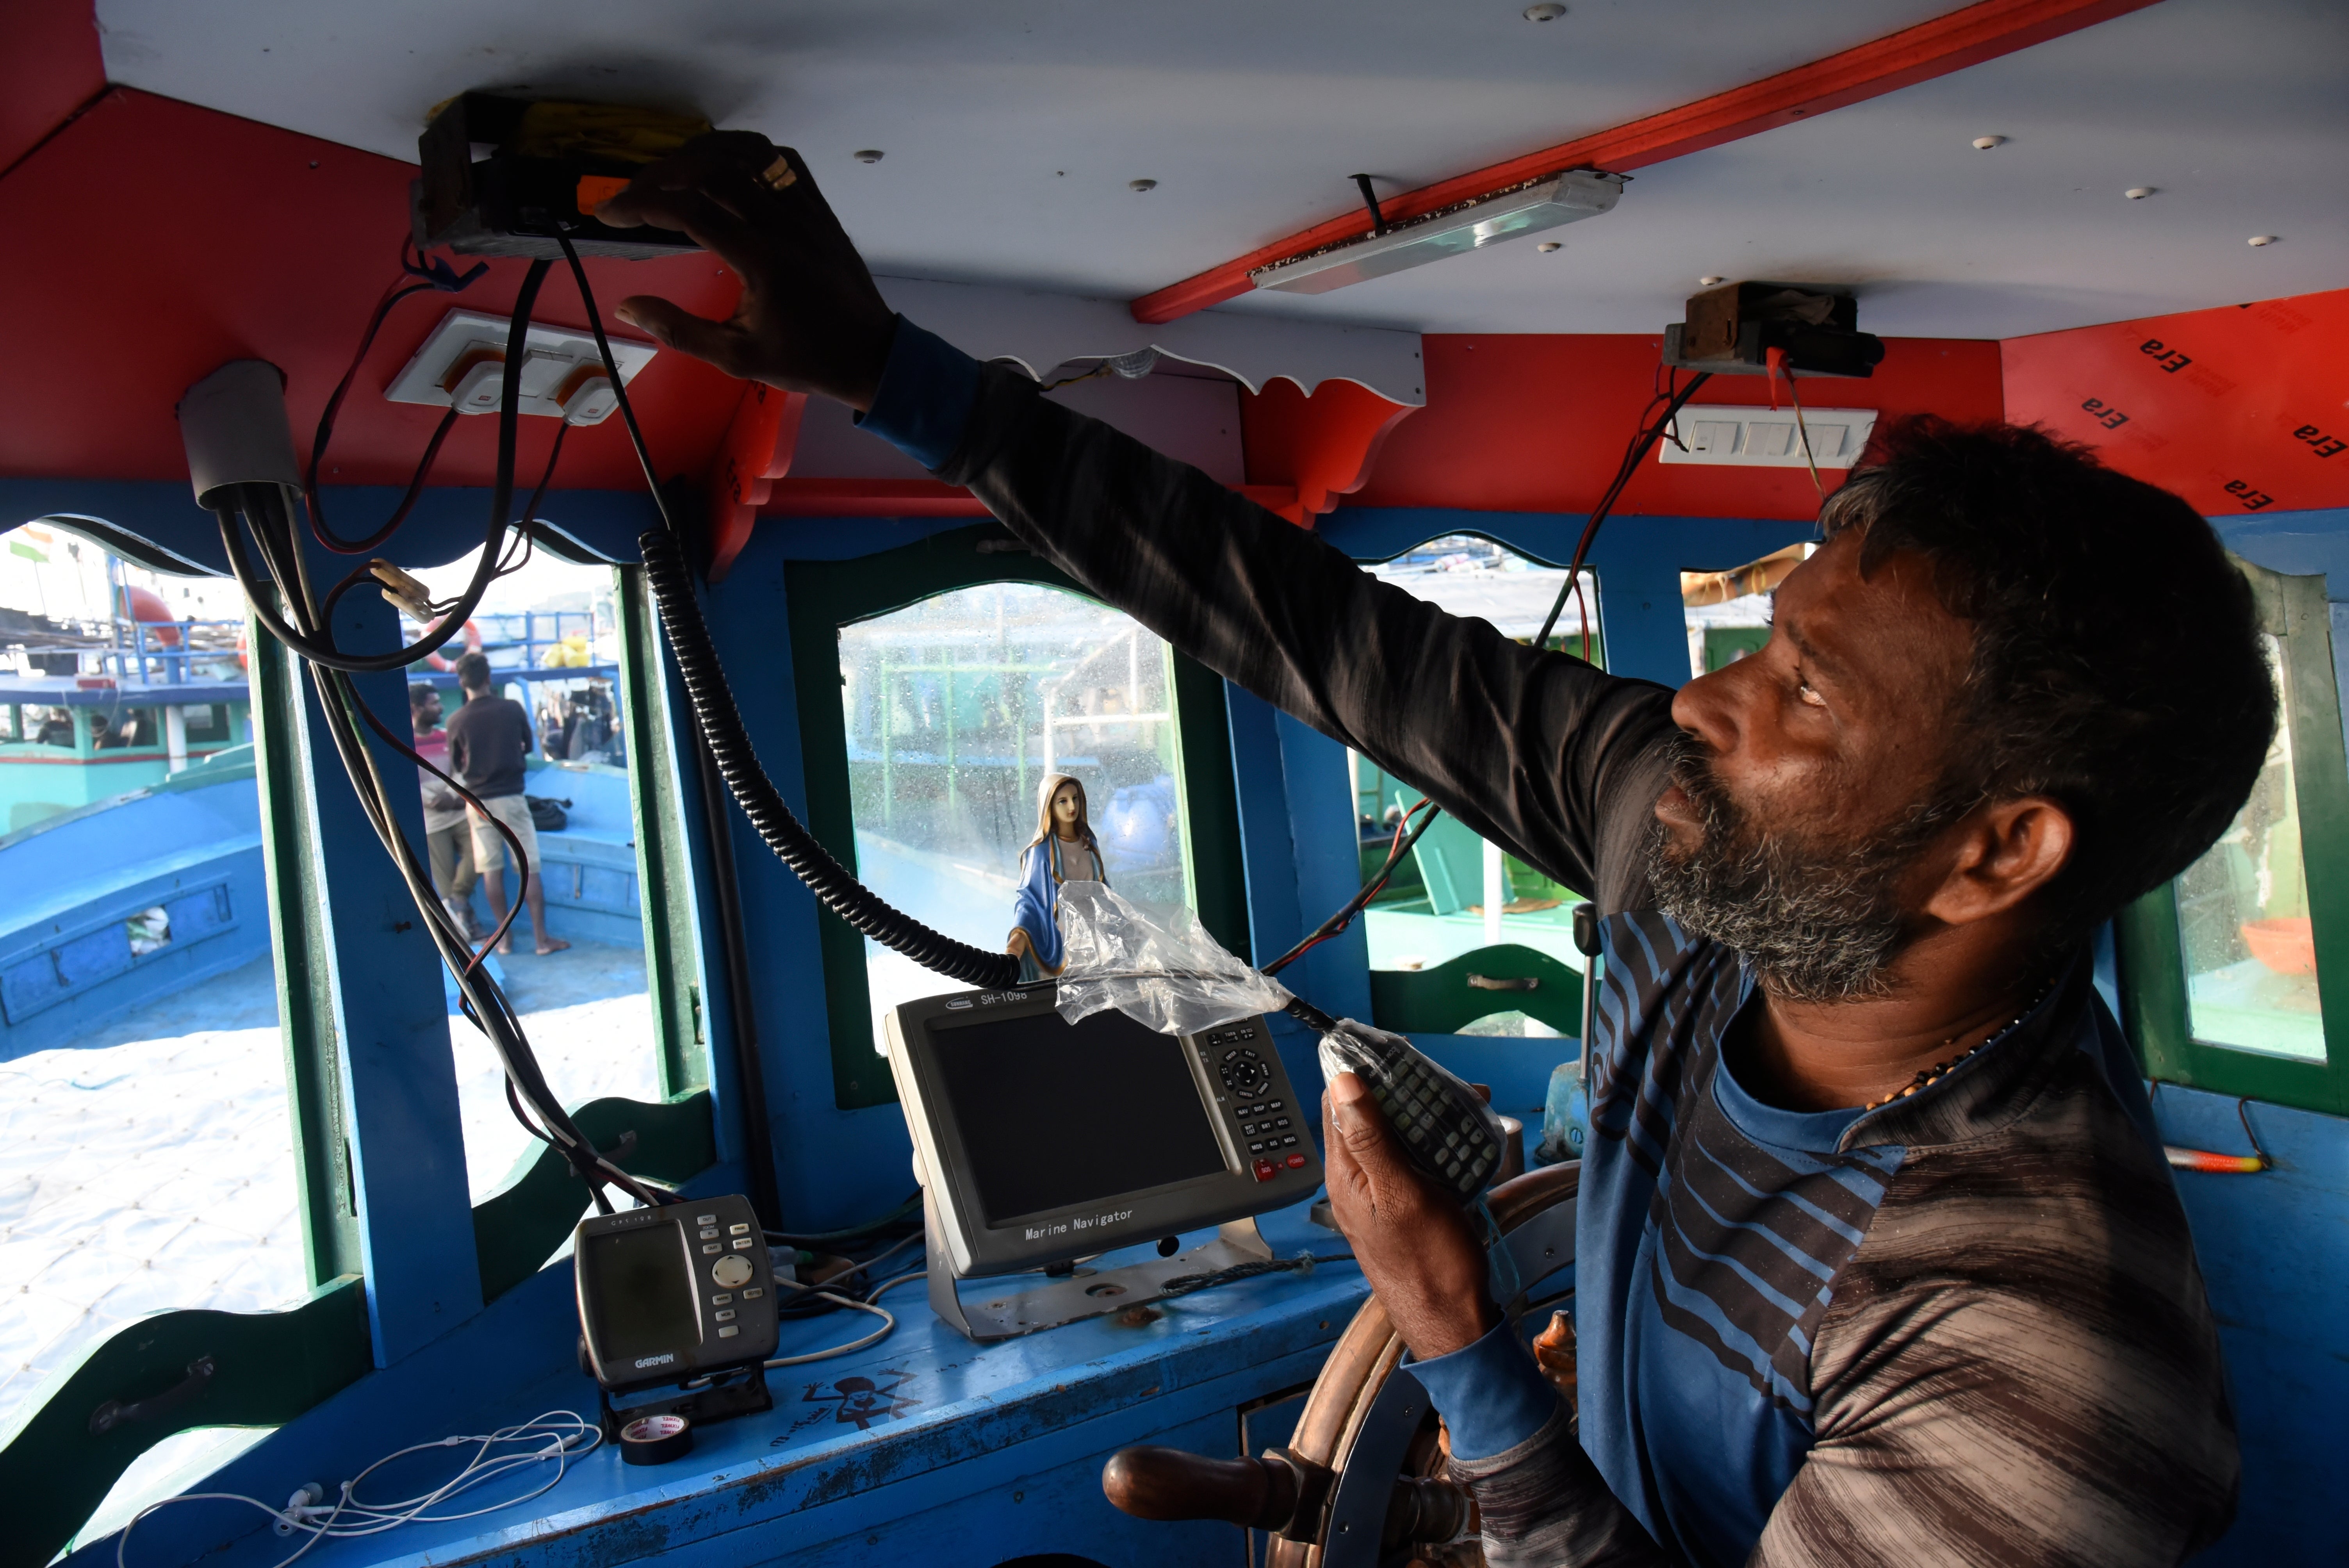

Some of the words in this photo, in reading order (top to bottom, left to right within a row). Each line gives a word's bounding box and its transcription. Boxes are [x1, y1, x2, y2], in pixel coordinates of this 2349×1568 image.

[2140, 339, 2192, 373] Era
[2082, 398, 2129, 429] Era
[2294, 425, 2347, 458] Era
[2224, 480, 2274, 510] Era
[1226, 1051, 1237, 1060] ENTER
[1025, 1224, 1067, 1240] Marine
[1074, 1210, 1132, 1230] Navigator
[635, 1354, 673, 1368] GARMIN
